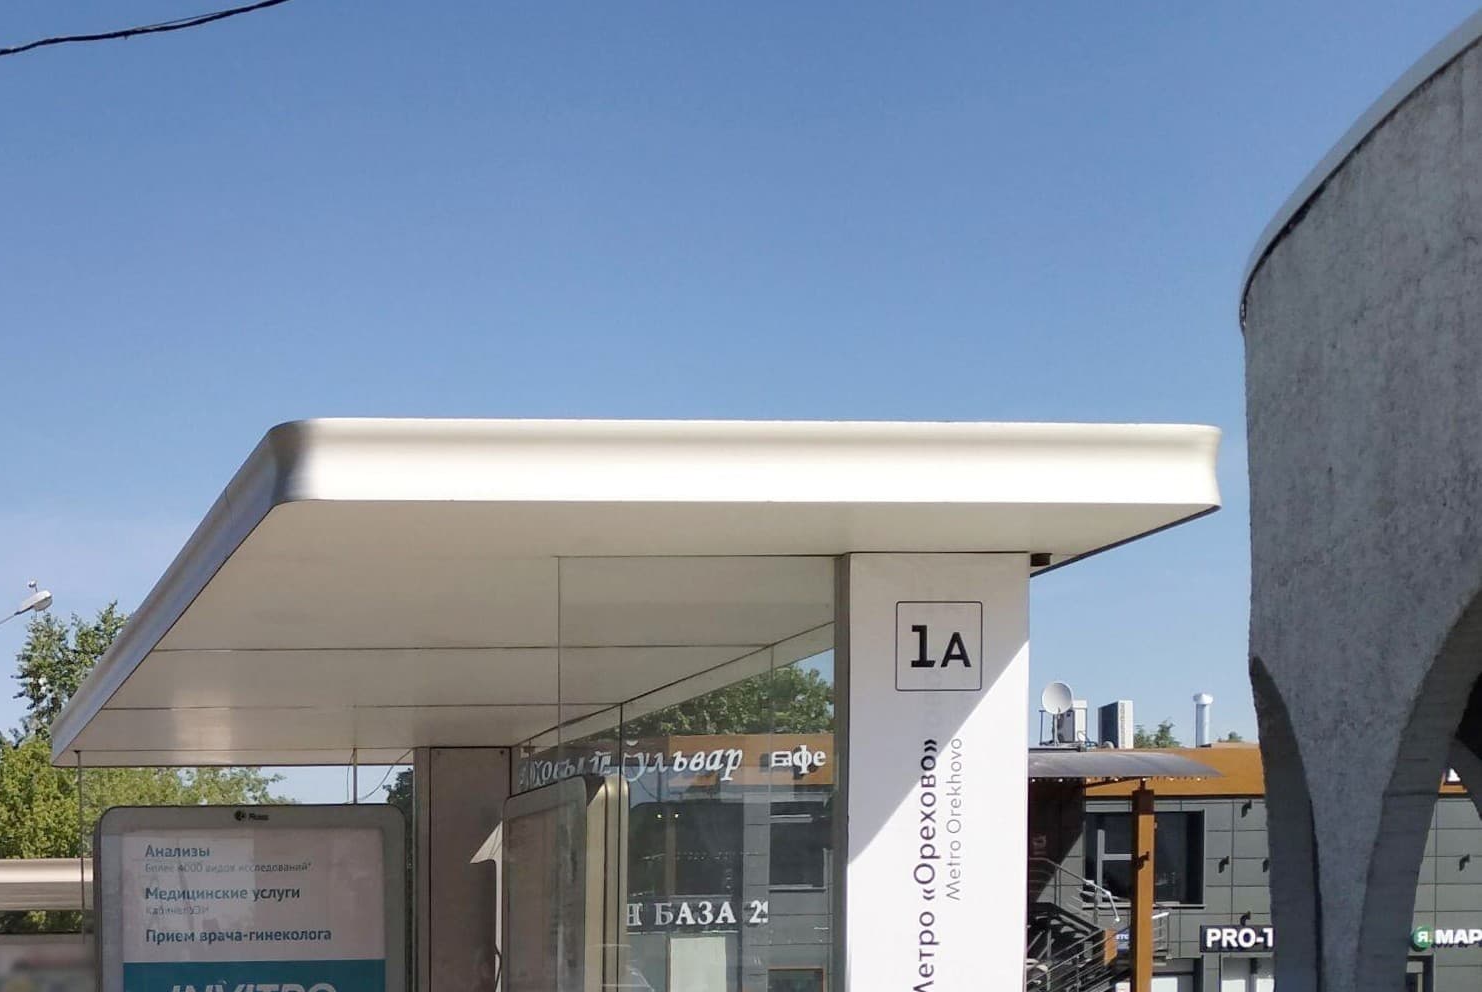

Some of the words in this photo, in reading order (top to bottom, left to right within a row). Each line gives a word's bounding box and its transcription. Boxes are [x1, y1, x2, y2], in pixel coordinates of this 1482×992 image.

[946, 738, 962, 835] Orekhovo
[913, 738, 941, 901] «Орехово»
[145, 845, 210, 858] Анализы
[946, 840, 962, 901] Metro
[145, 887, 248, 901] Медицинские
[253, 887, 300, 902] услуги
[654, 900, 737, 926] БАЗА
[146, 929, 195, 945] Прием
[199, 928, 333, 945] врача-гинеколога
